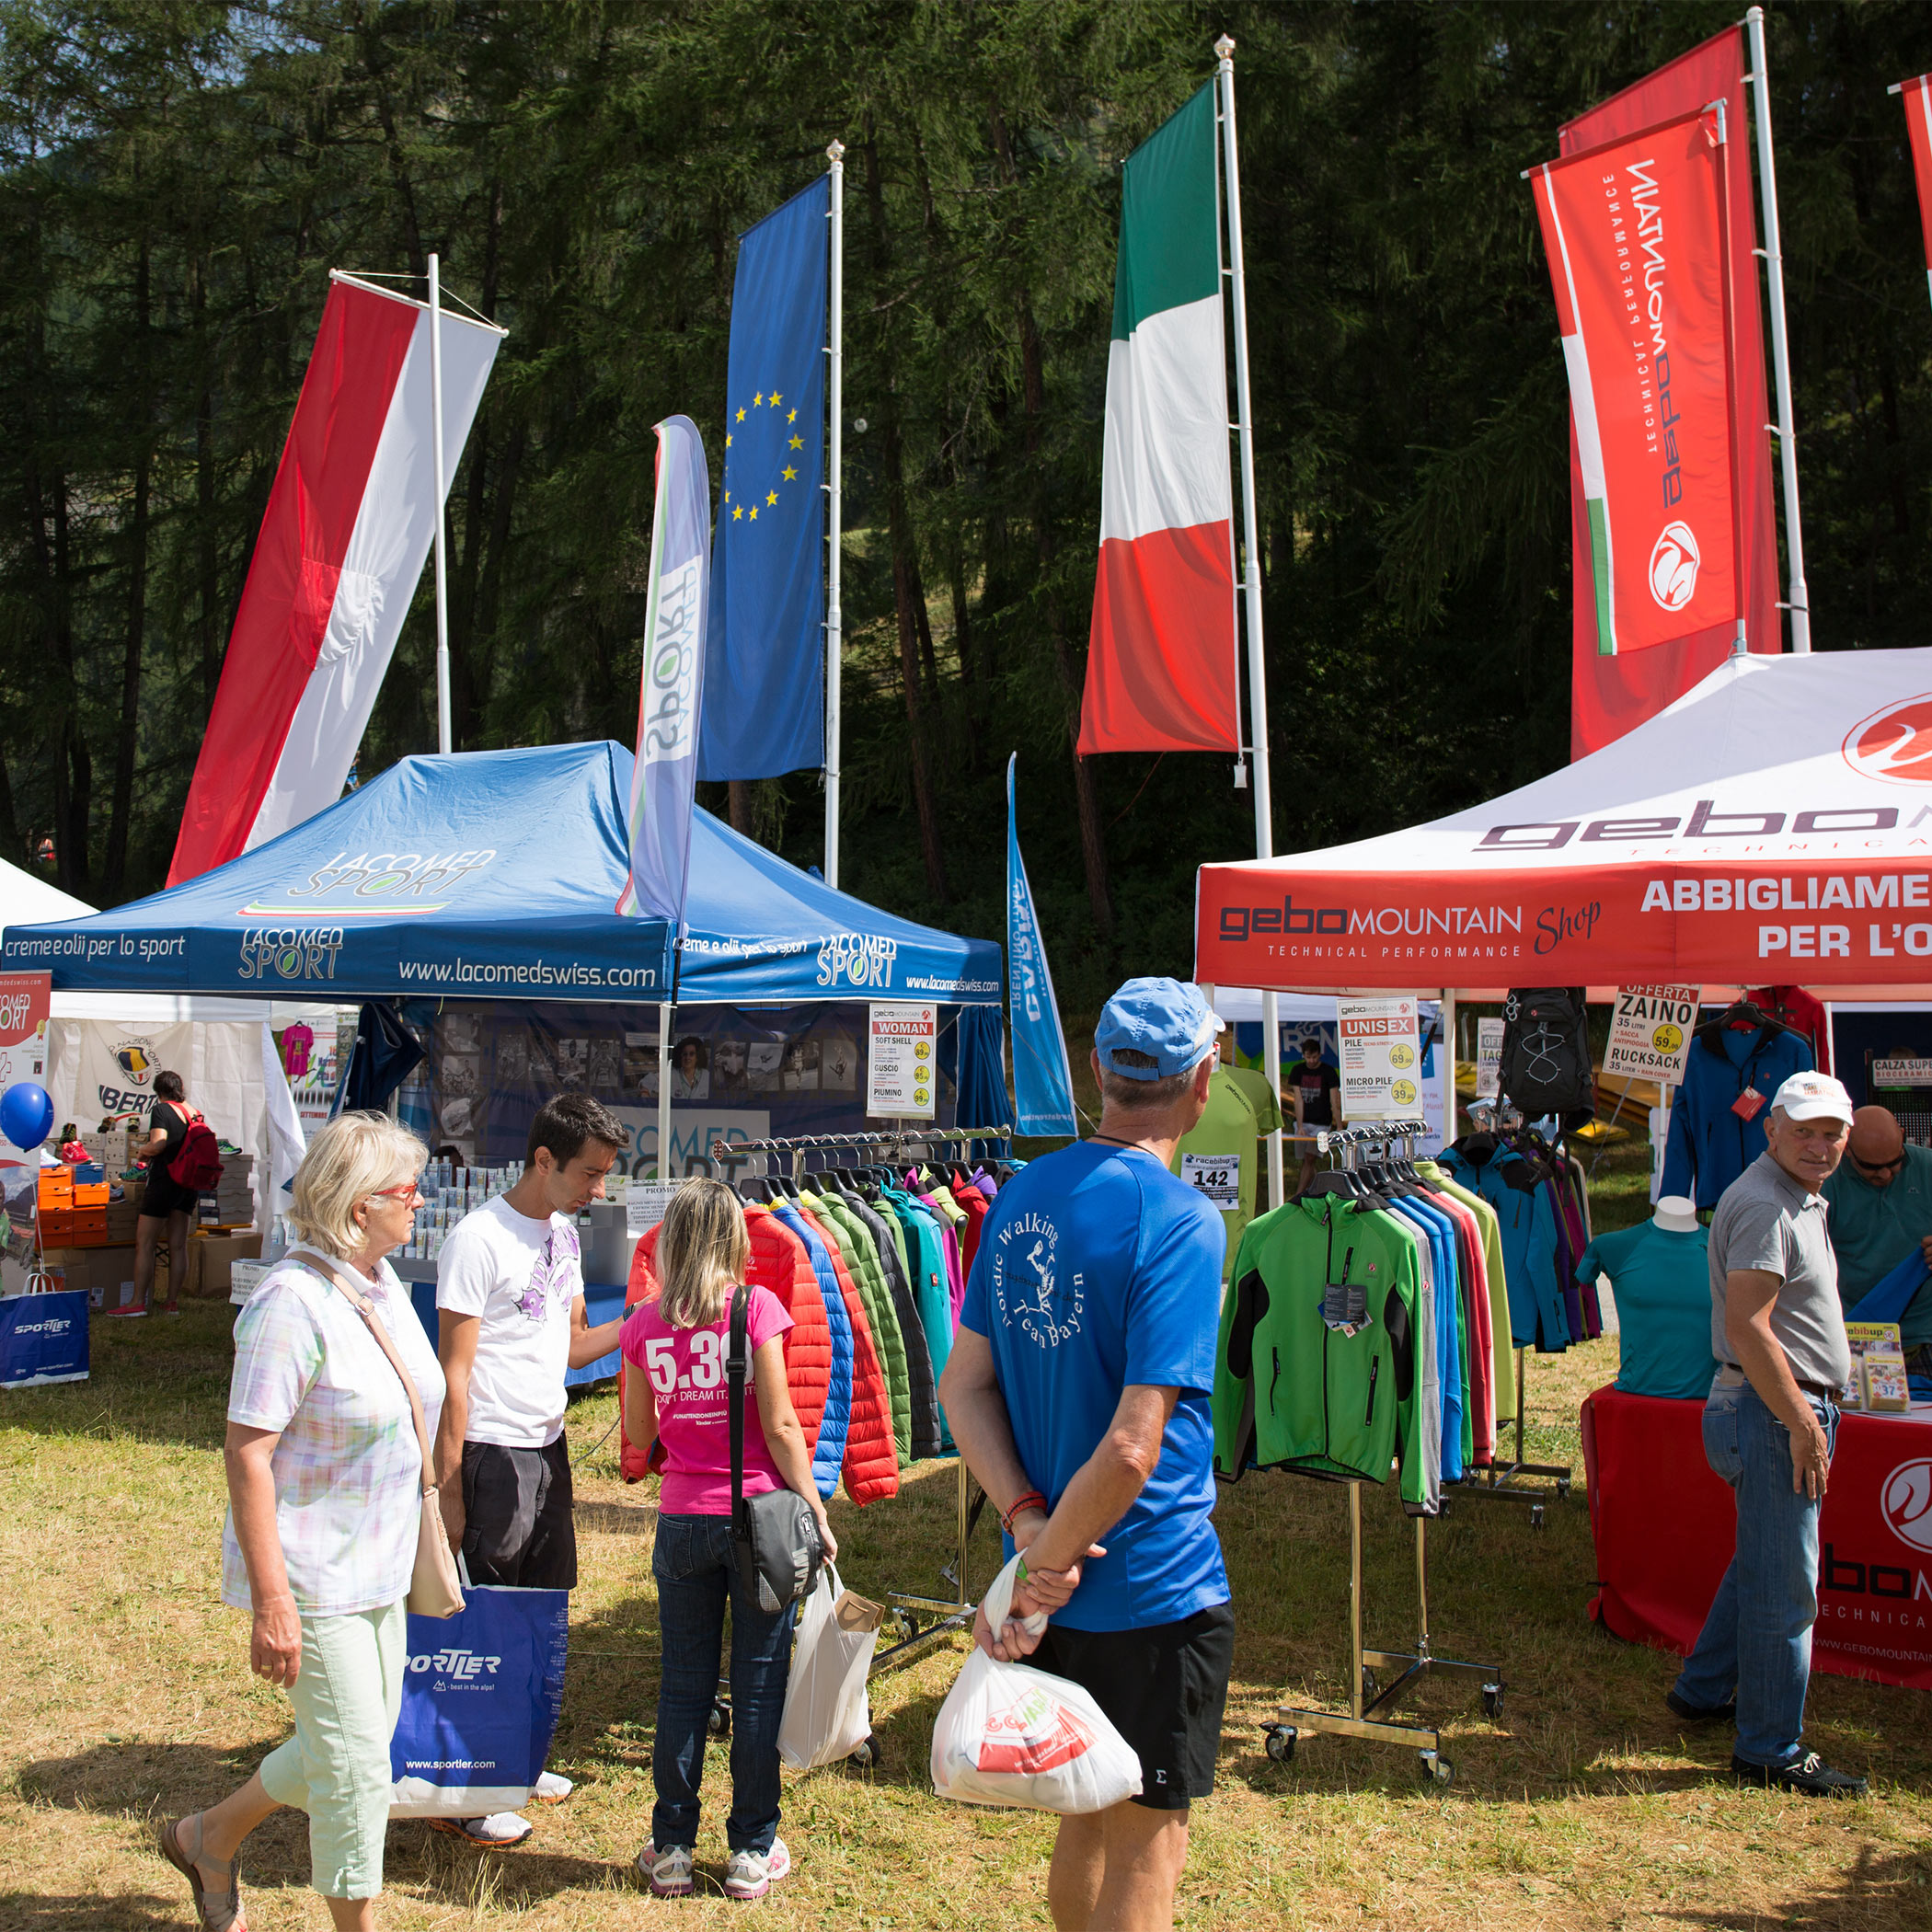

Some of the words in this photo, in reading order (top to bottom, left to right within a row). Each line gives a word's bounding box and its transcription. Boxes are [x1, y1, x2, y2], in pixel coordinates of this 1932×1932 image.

[287, 864, 484, 897] SPORT
[1534, 900, 1601, 955] Shop
[243, 927, 344, 949] LACOMED
[819, 932, 898, 958] LACOMED
[1758, 926, 1851, 958] PER
[87, 937, 116, 962] per
[120, 934, 135, 955] lo
[139, 935, 186, 963] sport
[712, 941, 720, 953] e
[742, 943, 762, 959] per
[761, 942, 777, 954] lo
[778, 939, 808, 958] sport
[1269, 945, 1368, 958] TECHNICAL
[1382, 945, 1521, 958] PERFORMANCE
[237, 943, 343, 980] SPORT
[816, 949, 897, 988] SPORT
[399, 958, 657, 987] www.lacomedswiss.com
[906, 974, 999, 993] www.lacomedswiss.com
[0, 994, 31, 1010] OMED
[1618, 994, 1692, 1025] ZAINO
[879, 1022, 928, 1034] WOMAN
[1346, 1019, 1409, 1035] UNISEX
[1616, 1018, 1630, 1028] 35
[891, 1037, 912, 1045] SHELL
[1619, 1030, 1639, 1039] SACCA
[1345, 1039, 1362, 1047] PILE
[1613, 1037, 1650, 1049] ANTIPIOGGIA
[1608, 1061, 1621, 1071] 35
[1611, 1048, 1681, 1070] RUCKSACK
[1875, 1060, 1905, 1070] CALZA
[874, 1064, 899, 1073] GUSCIO
[1346, 1077, 1374, 1086] MICRO
[873, 1088, 903, 1097] PIUMINO
[1193, 1170, 1228, 1186] 142
[998, 1213, 1059, 1250] Walking
[1047, 1272, 1085, 1348] Bayern
[14, 1318, 71, 1334] SPORTLER
[681, 1390, 714, 1401] DREAM
[716, 1389, 729, 1399] IT.
[1822, 1604, 1926, 1628] ECHNICA
[450, 1683, 462, 1691] best
[463, 1683, 469, 1691] in
[470, 1683, 480, 1691] the
[480, 1683, 495, 1693] alps!
[406, 1758, 496, 1771] www.sportler.com
